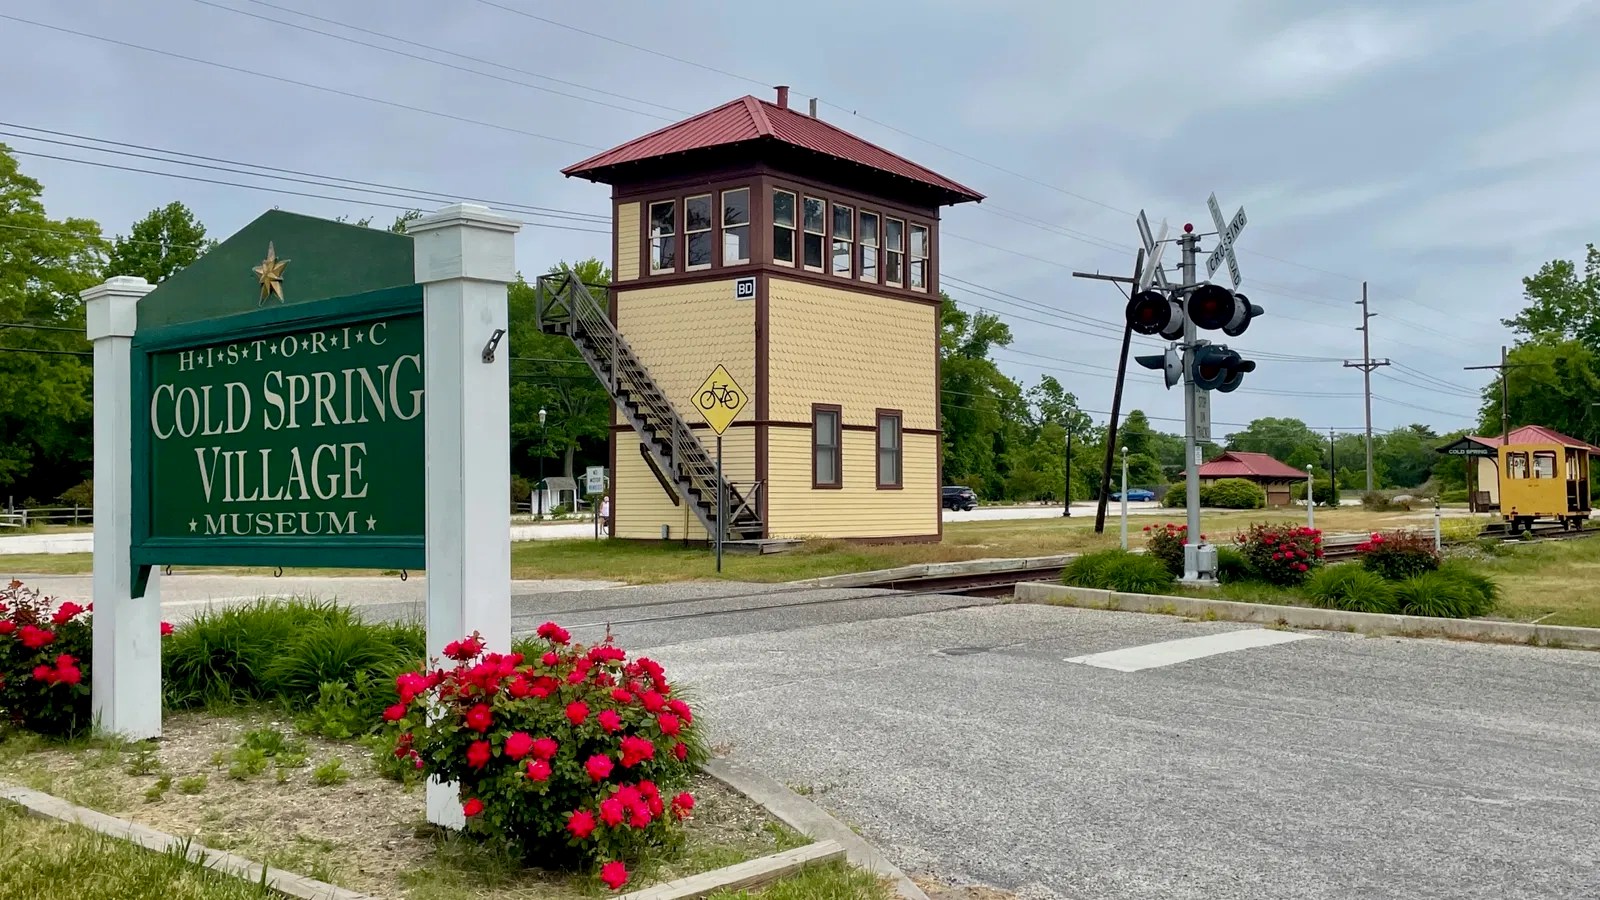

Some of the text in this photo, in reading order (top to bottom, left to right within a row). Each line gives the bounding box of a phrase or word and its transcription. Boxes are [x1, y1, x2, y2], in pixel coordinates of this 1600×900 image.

[1210, 213, 1244, 271] CROSSING
[739, 283, 752, 295] BD
[151, 353, 425, 440] COLD SPRING
[194, 442, 369, 503] VILLAGE
[204, 511, 358, 535] MUSEUM
